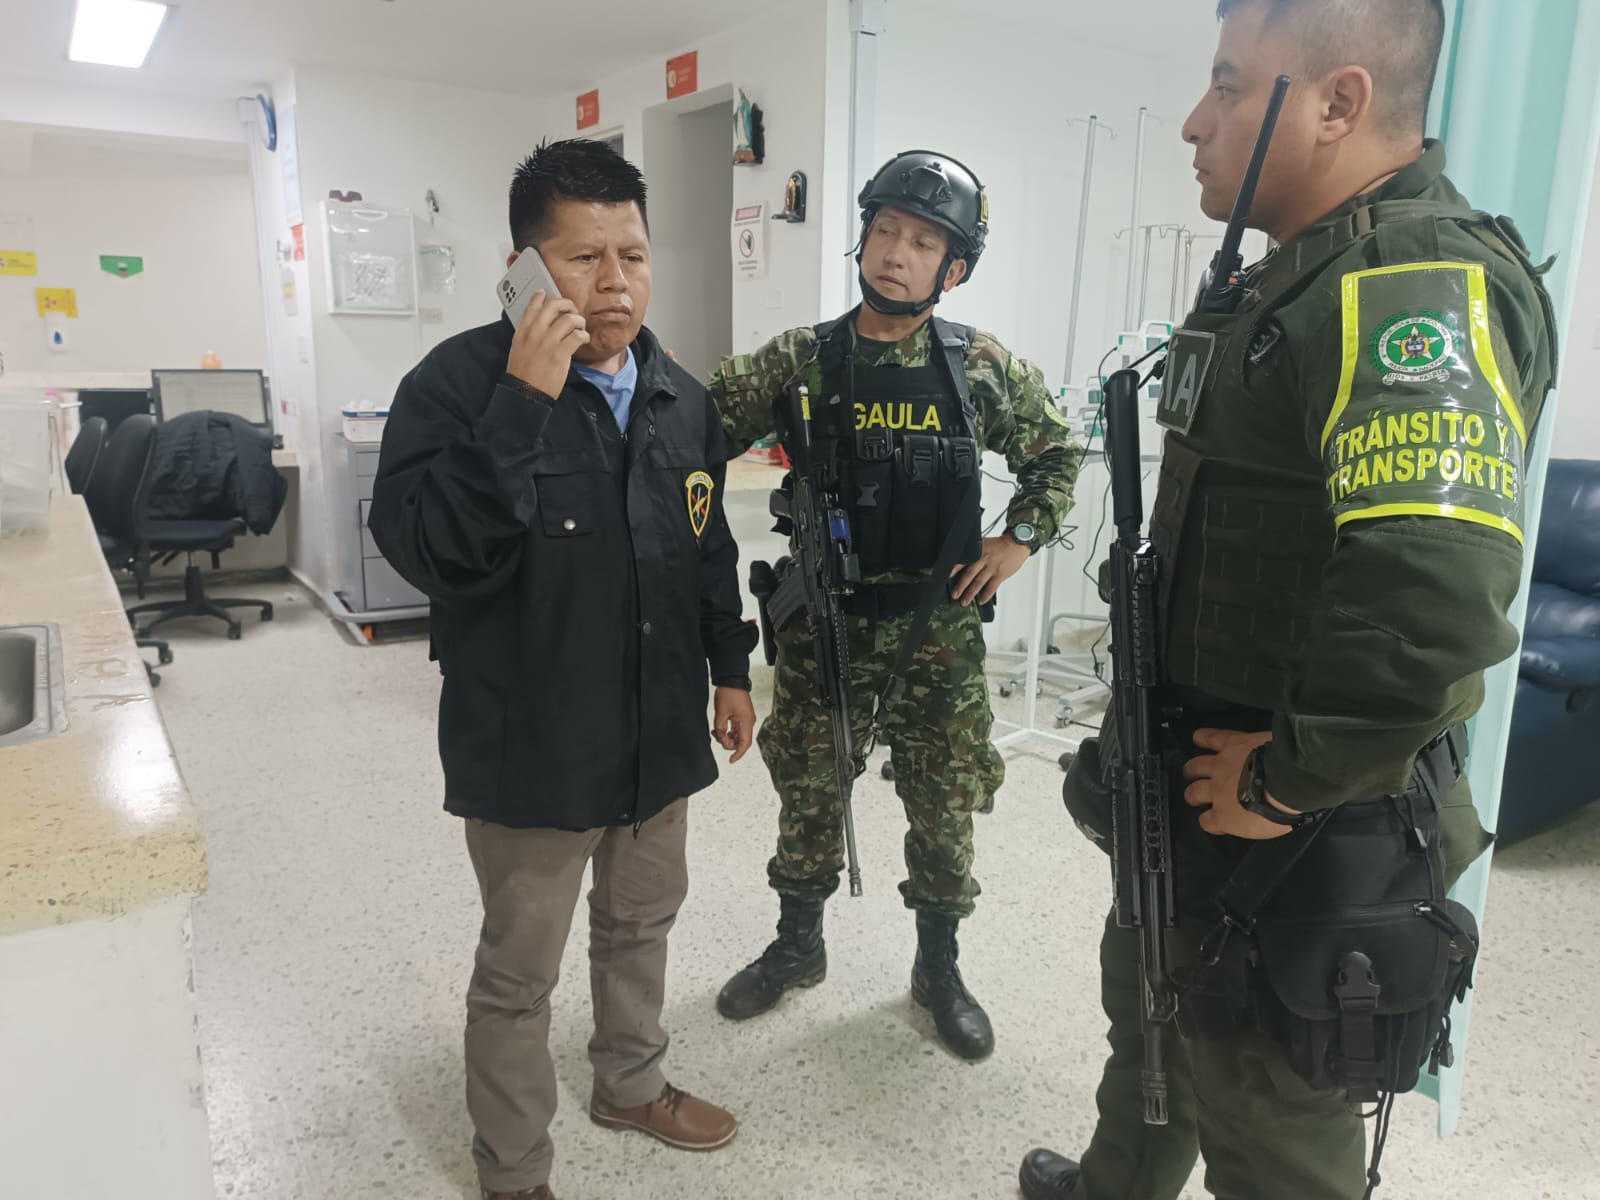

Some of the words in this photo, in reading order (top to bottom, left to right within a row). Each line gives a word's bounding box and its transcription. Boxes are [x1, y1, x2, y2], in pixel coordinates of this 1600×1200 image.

[853, 402, 942, 431] GAULA
[1336, 411, 1485, 465] TRÁNSITO
[1495, 420, 1508, 456] Y
[1328, 448, 1514, 505] TRANSPORTE
